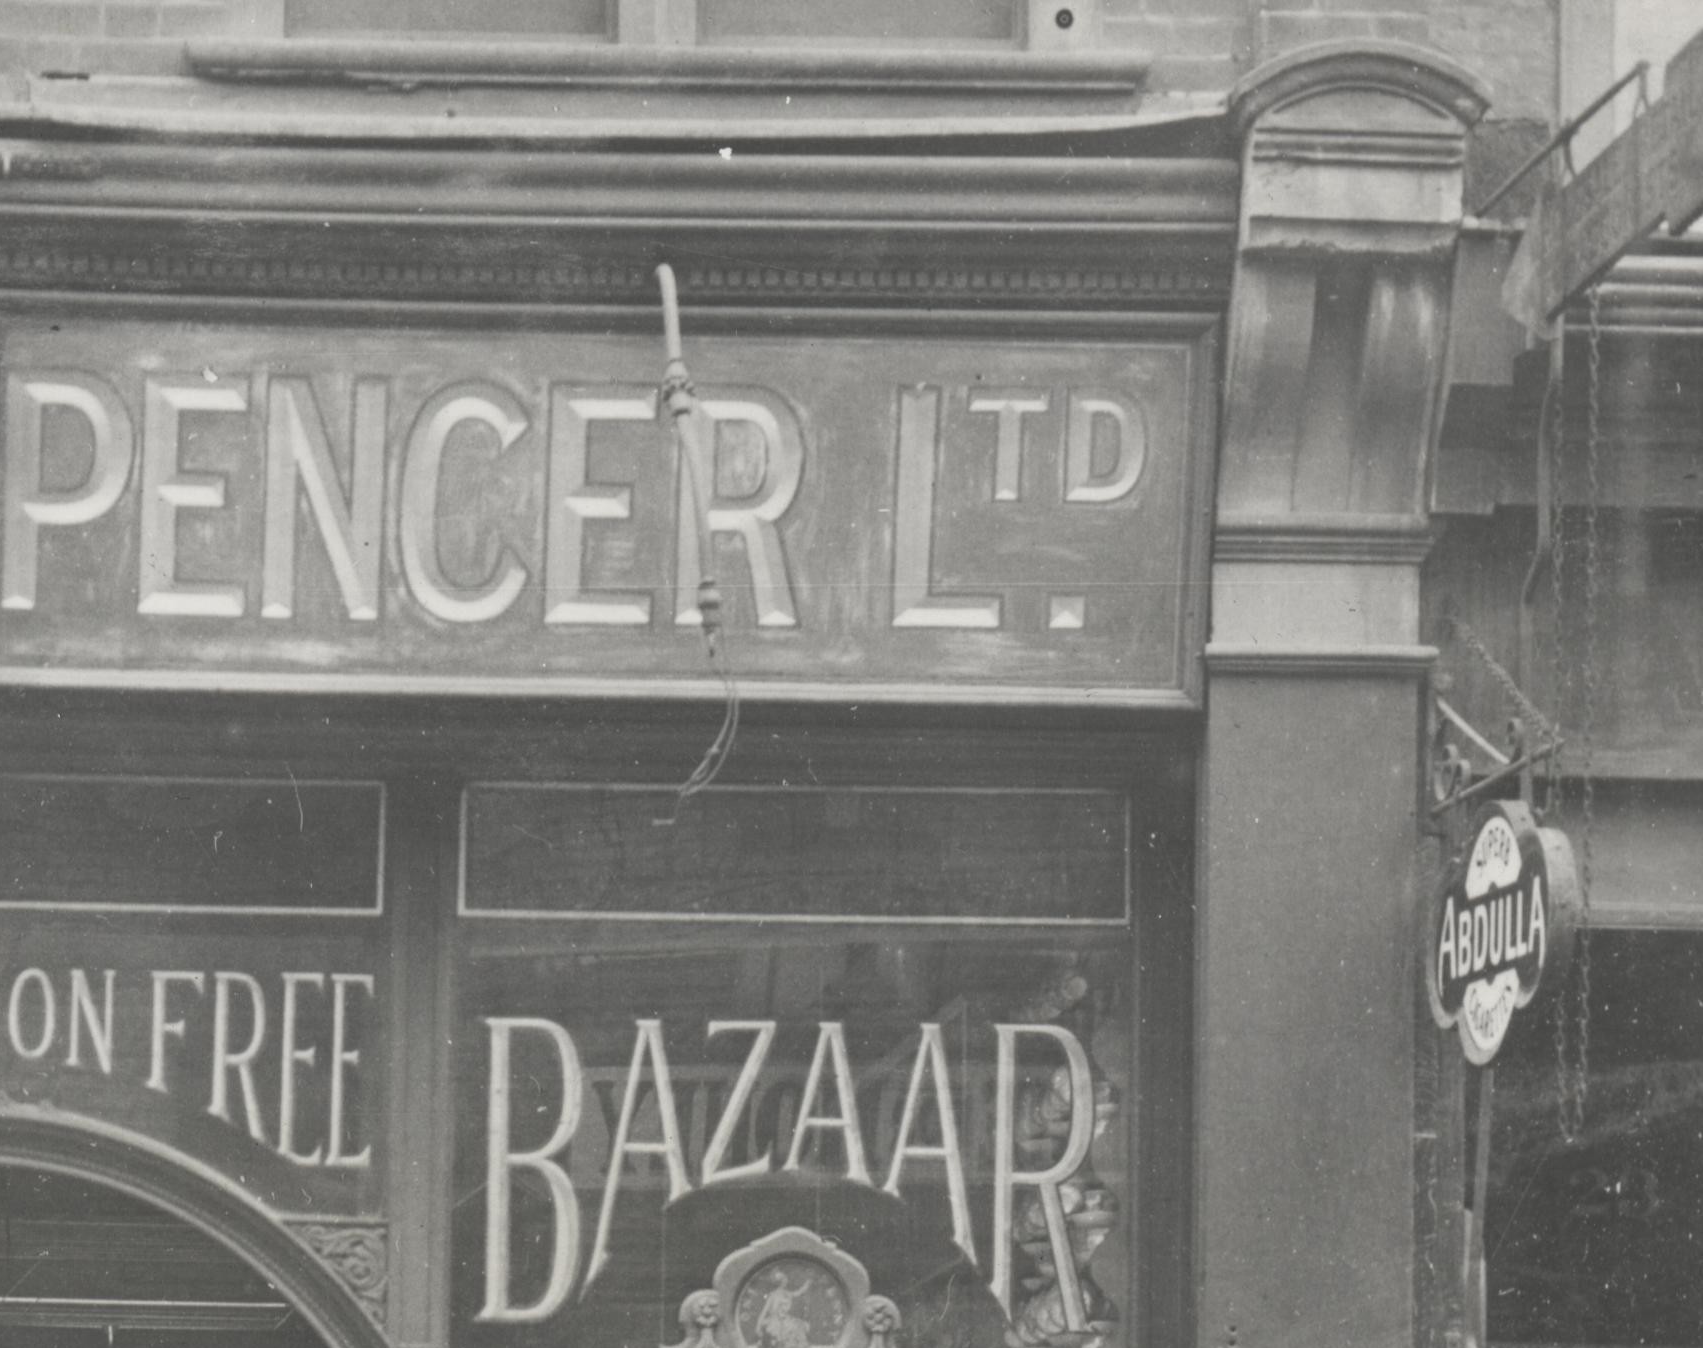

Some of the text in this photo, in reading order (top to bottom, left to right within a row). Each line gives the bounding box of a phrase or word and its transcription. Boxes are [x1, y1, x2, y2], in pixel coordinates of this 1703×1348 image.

[1438, 875, 1546, 997] ABDULLA
[147, 969, 375, 1168] FREE
[474, 1015, 1097, 1334] BAZAAR
